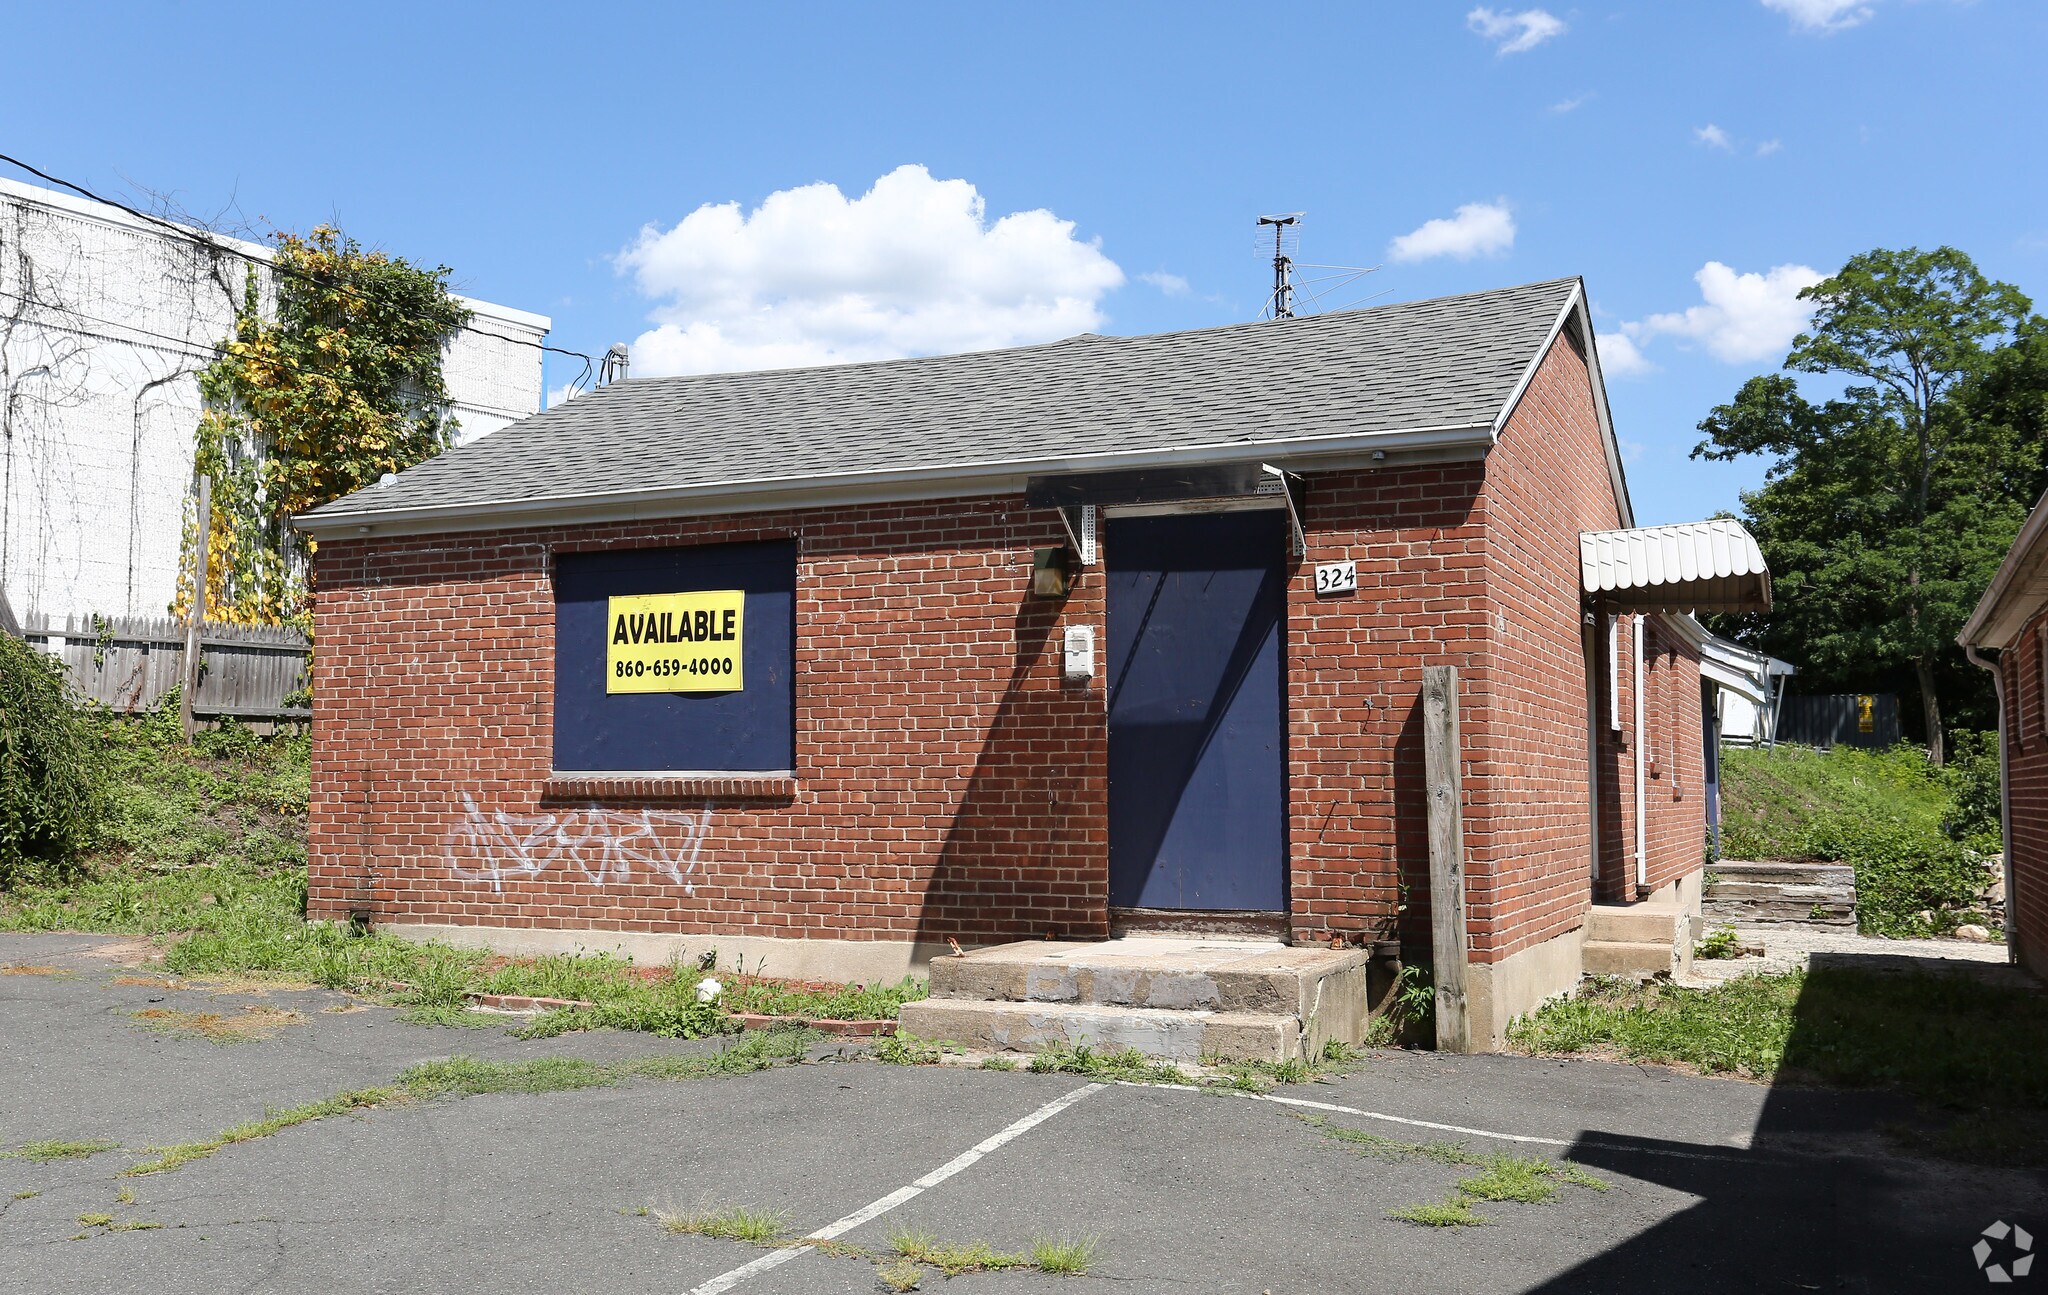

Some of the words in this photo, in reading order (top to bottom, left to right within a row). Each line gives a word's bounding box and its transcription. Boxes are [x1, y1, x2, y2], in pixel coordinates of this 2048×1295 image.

[1318, 566, 1355, 590] 324
[613, 609, 736, 645] AVAILABLE
[615, 657, 733, 678] 860-659-4000
